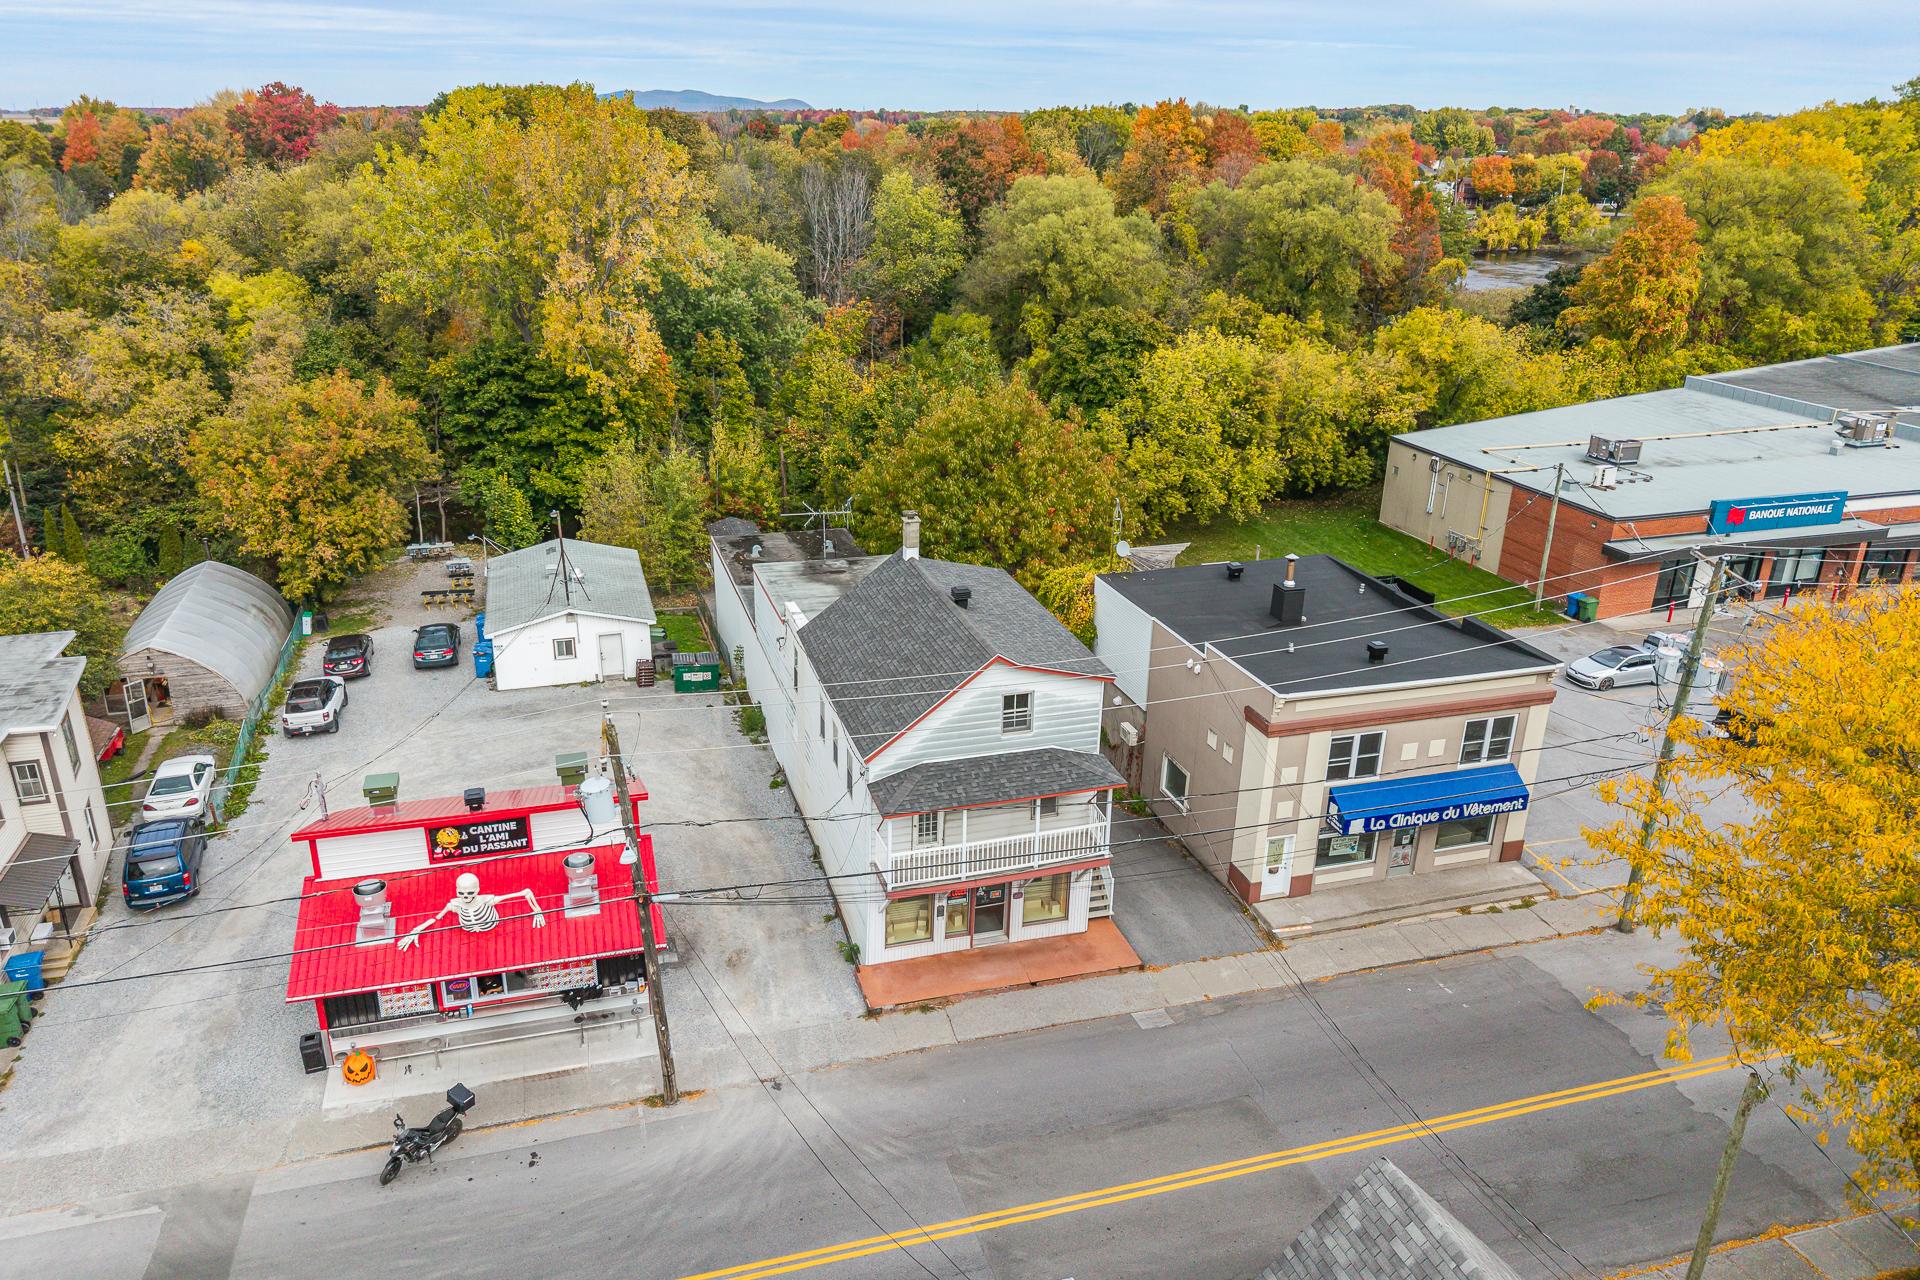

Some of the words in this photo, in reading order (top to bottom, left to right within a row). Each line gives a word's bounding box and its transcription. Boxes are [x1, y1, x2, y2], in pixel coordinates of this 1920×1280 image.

[1749, 507, 1785, 520] BANQUE
[1786, 504, 1833, 516] NATIONALE
[1370, 817, 1385, 830] La
[1389, 812, 1439, 828] Clinique
[1442, 806, 1460, 819] du
[1463, 798, 1525, 816] Vêtement
[469, 821, 517, 834] CANTINE
[479, 832, 509, 843] L'AMI
[462, 845, 478, 854] DU
[480, 838, 528, 851] PASSANT
